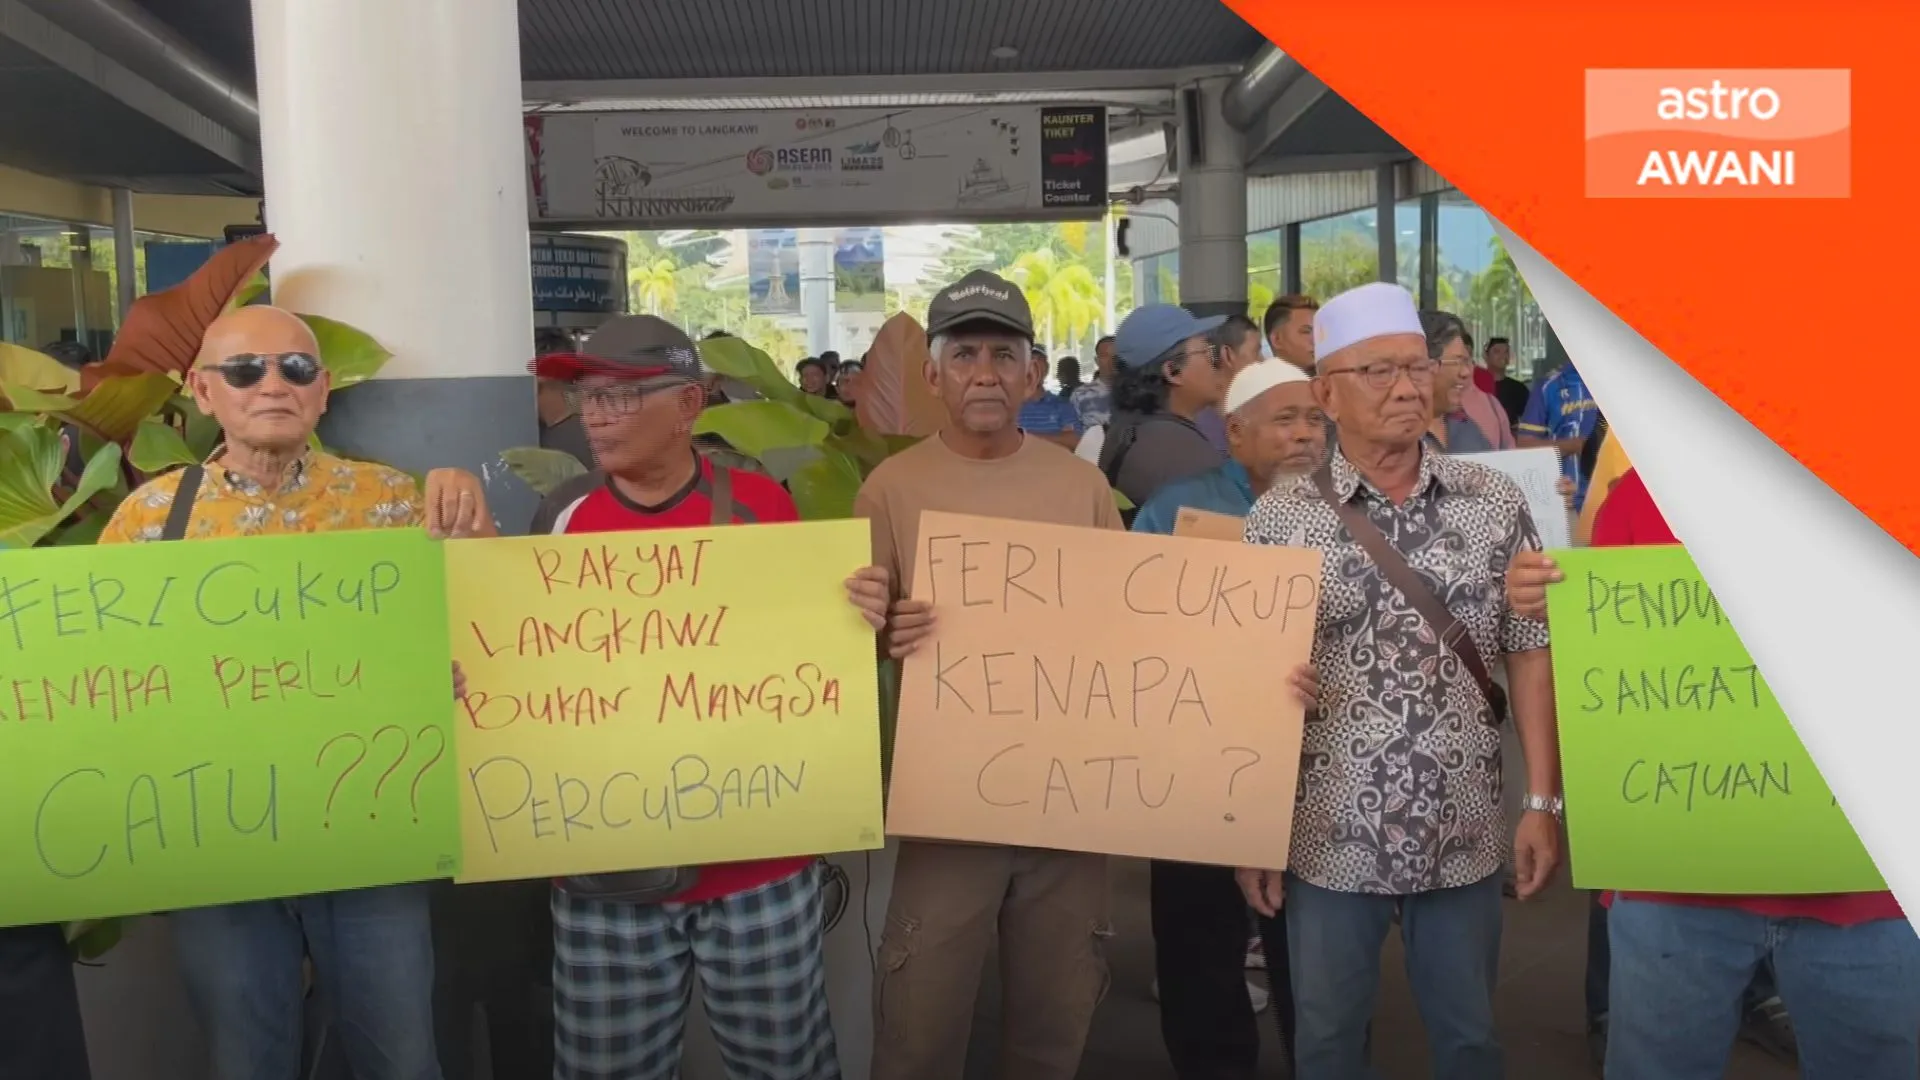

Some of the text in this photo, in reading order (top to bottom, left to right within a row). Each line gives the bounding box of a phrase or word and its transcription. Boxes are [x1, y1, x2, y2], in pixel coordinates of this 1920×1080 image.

[620, 124, 759, 137] WELCOME TO LANGKAWI
[1043, 114, 1094, 124] KAUNTER
[1043, 127, 1076, 138] TIKET
[777, 148, 832, 163] ASEAN
[1044, 180, 1082, 190] Ticket
[1044, 193, 1092, 203] Counter
[533, 539, 714, 598] RAKYAT
[929, 535, 1317, 633] FERI CUKUP
[1586, 571, 1730, 635] PENDU
[471, 606, 729, 662] LANGKAWI
[463, 662, 840, 730] BUKAN MANGSA
[935, 641, 1212, 727] KENAPA
[1580, 664, 1759, 714] SANGAT
[35, 725, 445, 879] CATU ???
[977, 743, 1261, 822] CATU ?
[1622, 759, 1792, 811] CATUAN
